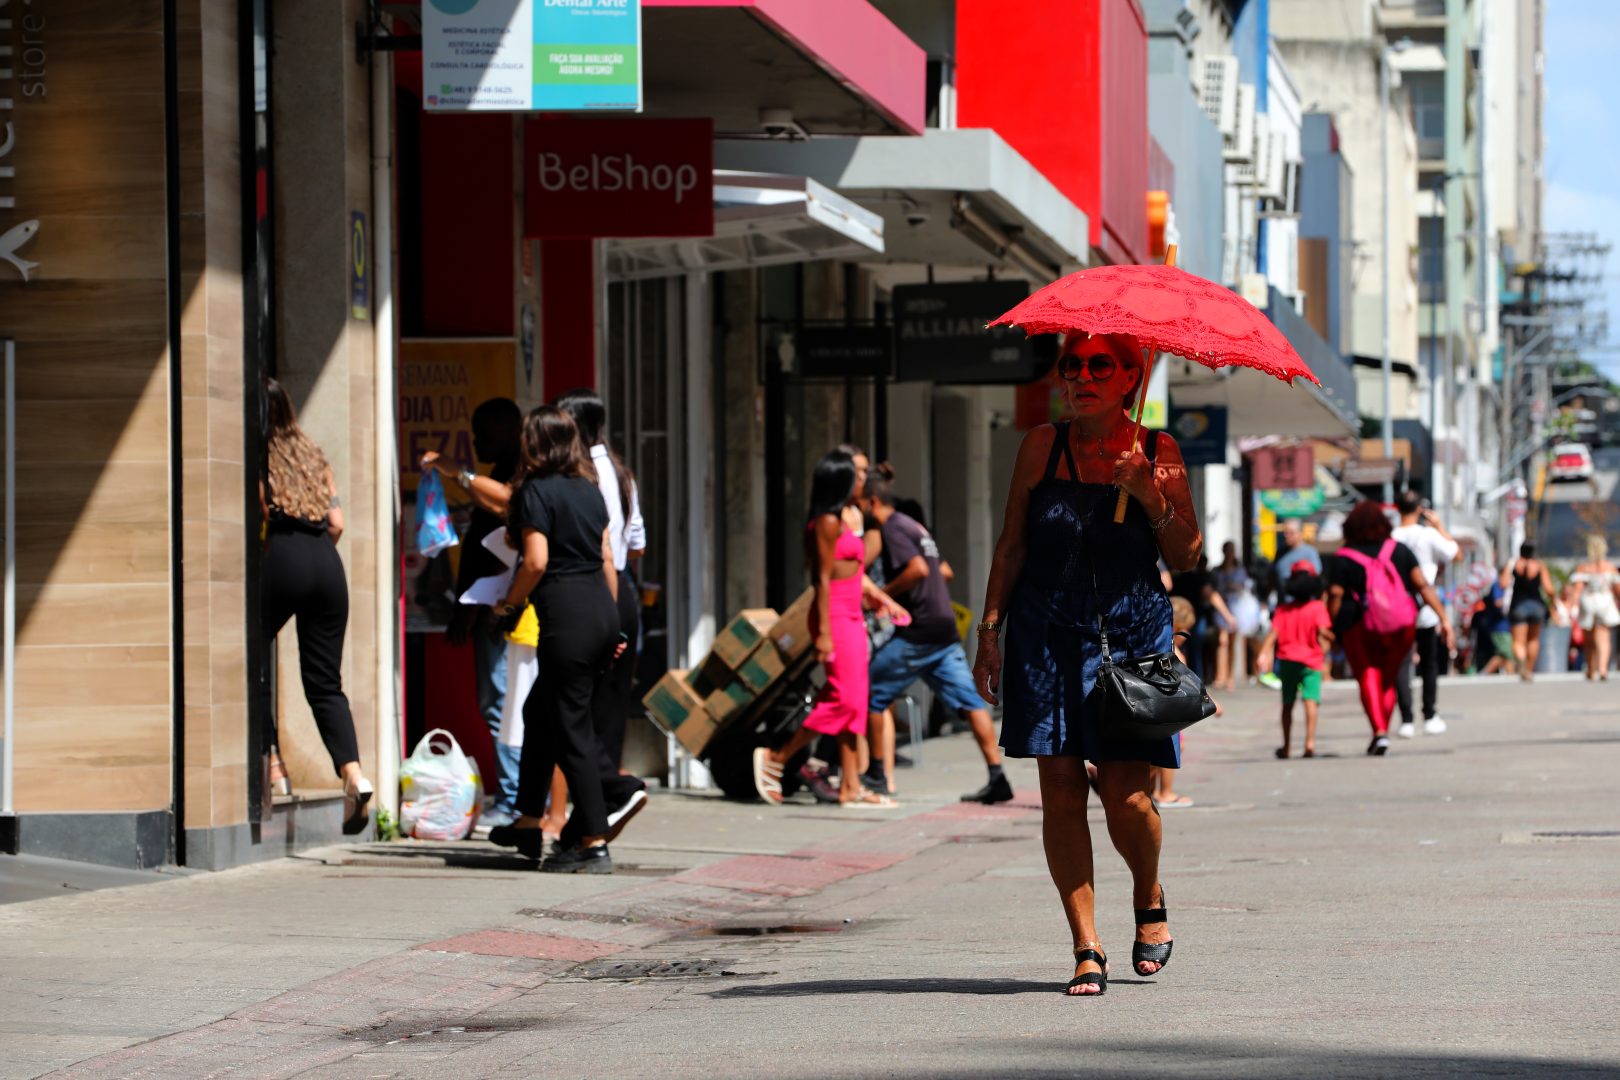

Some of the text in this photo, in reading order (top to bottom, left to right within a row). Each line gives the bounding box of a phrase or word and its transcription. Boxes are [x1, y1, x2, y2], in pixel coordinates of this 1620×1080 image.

[18, 14, 46, 97] store
[538, 153, 698, 204] BelShop
[440, 395, 470, 422] DA
